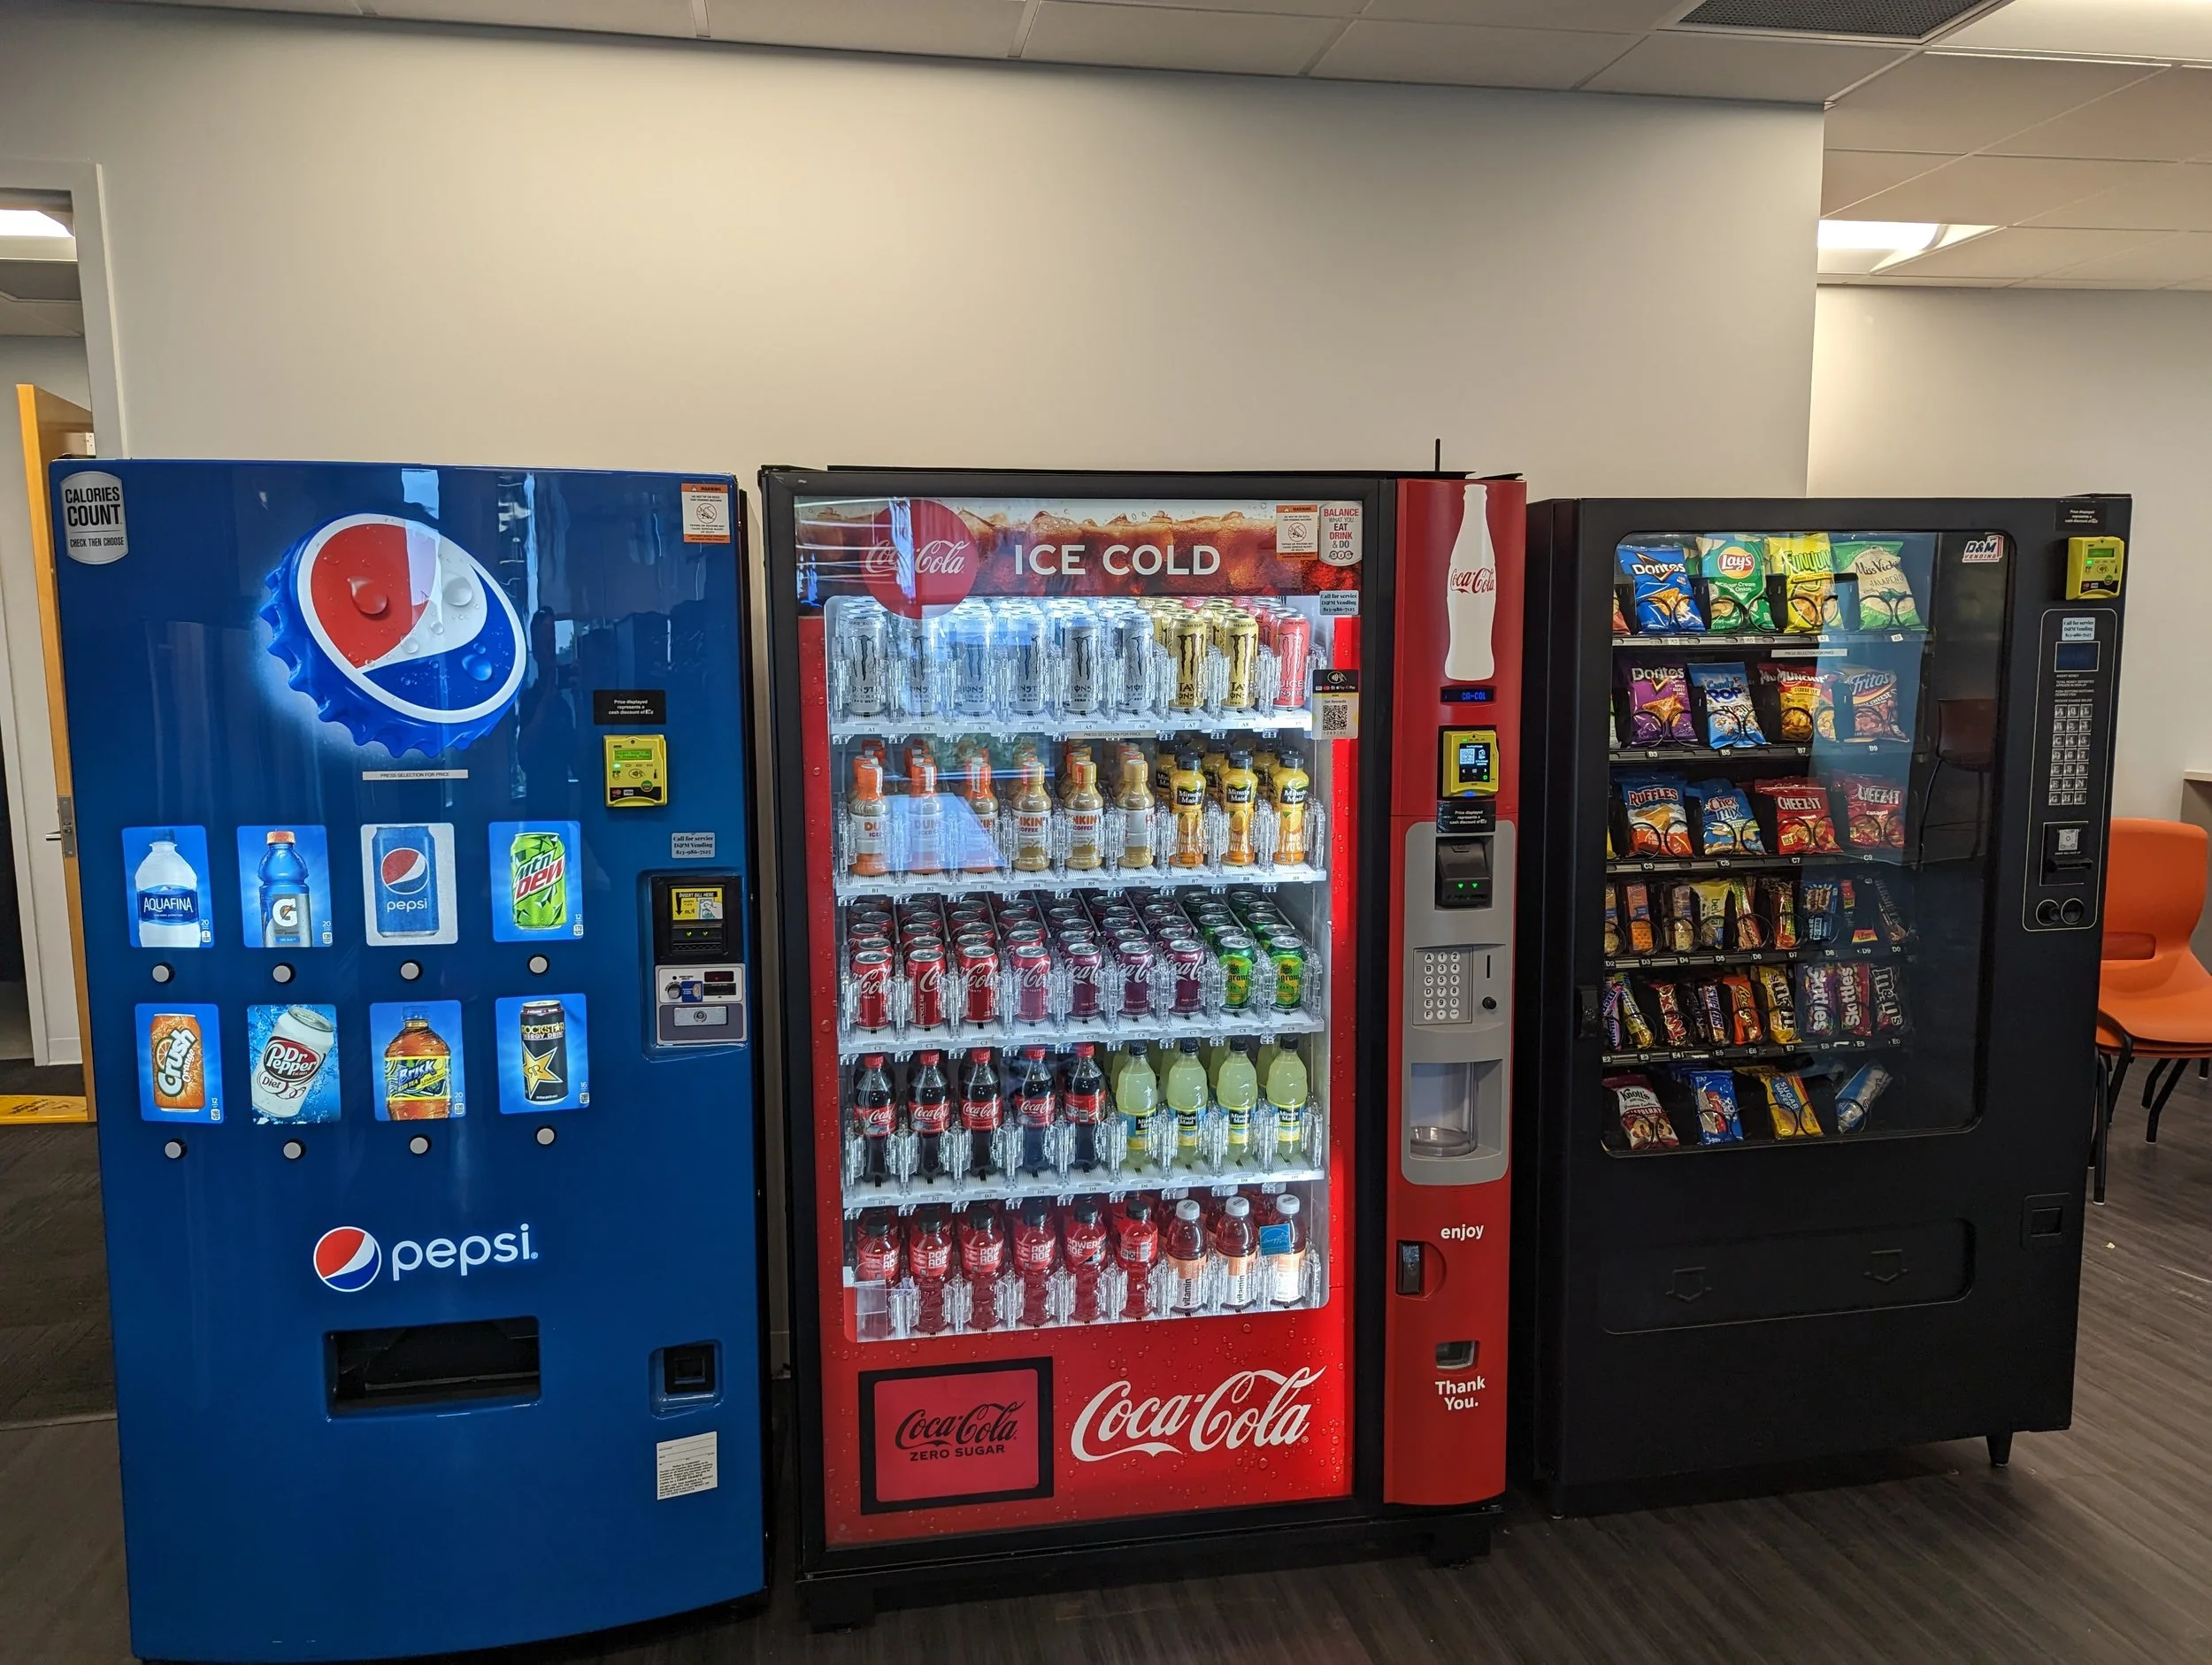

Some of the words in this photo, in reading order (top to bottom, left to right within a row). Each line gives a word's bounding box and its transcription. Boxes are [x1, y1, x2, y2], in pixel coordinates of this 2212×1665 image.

[65, 487, 120, 503] CALORIES
[66, 503, 121, 526] COUNT
[70, 538, 87, 548] CHECK
[88, 537, 102, 547] THEN
[104, 536, 124, 546] CHOOSE
[1965, 541, 1997, 553] D&M
[1015, 544, 1087, 575] ICE
[1102, 544, 1221, 576] COLD
[1632, 563, 1686, 575] Doritos
[1720, 553, 1753, 573] Lay's
[1855, 562, 1877, 575] Miss
[1449, 567, 1495, 595] Coca-Cola
[1870, 574, 1903, 587] JALAPEÑO
[1632, 667, 1686, 681] Doritos
[1850, 672, 1890, 695] Fritos
[1629, 788, 1678, 806] RUFFLES
[1709, 796, 1737, 811] Chex
[1778, 796, 1823, 810] CHEEZ-IT
[1857, 785, 1901, 805] CHEEZ-IT
[143, 896, 194, 913] AQUAFINA
[272, 898, 298, 927] G
[387, 897, 428, 913] pepsi
[1807, 965, 1829, 1032] Skittles
[1839, 966, 1861, 1026] Skittles
[157, 1026, 197, 1096] Crush
[266, 1045, 318, 1077] Pepper
[283, 1047, 310, 1063] Dr
[181, 1048, 196, 1084] Orange
[398, 1059, 436, 1086] Brisk
[261, 1077, 281, 1090] Diet
[1619, 1088, 1651, 1101] Knott's
[1779, 1081, 1800, 1109] SUGAR
[1440, 1224, 1484, 1241] enjoy
[392, 1223, 530, 1281] pepsi
[1183, 1278, 1192, 1307] vitamin
[1435, 1376, 1486, 1395] Thank
[1071, 1364, 1327, 1462] Coca-Cola
[1444, 1396, 1479, 1411] You.
[895, 1400, 1026, 1450] Coca-Cola
[910, 1448, 953, 1462] ZERO
[955, 1444, 1006, 1458] SUGAR
